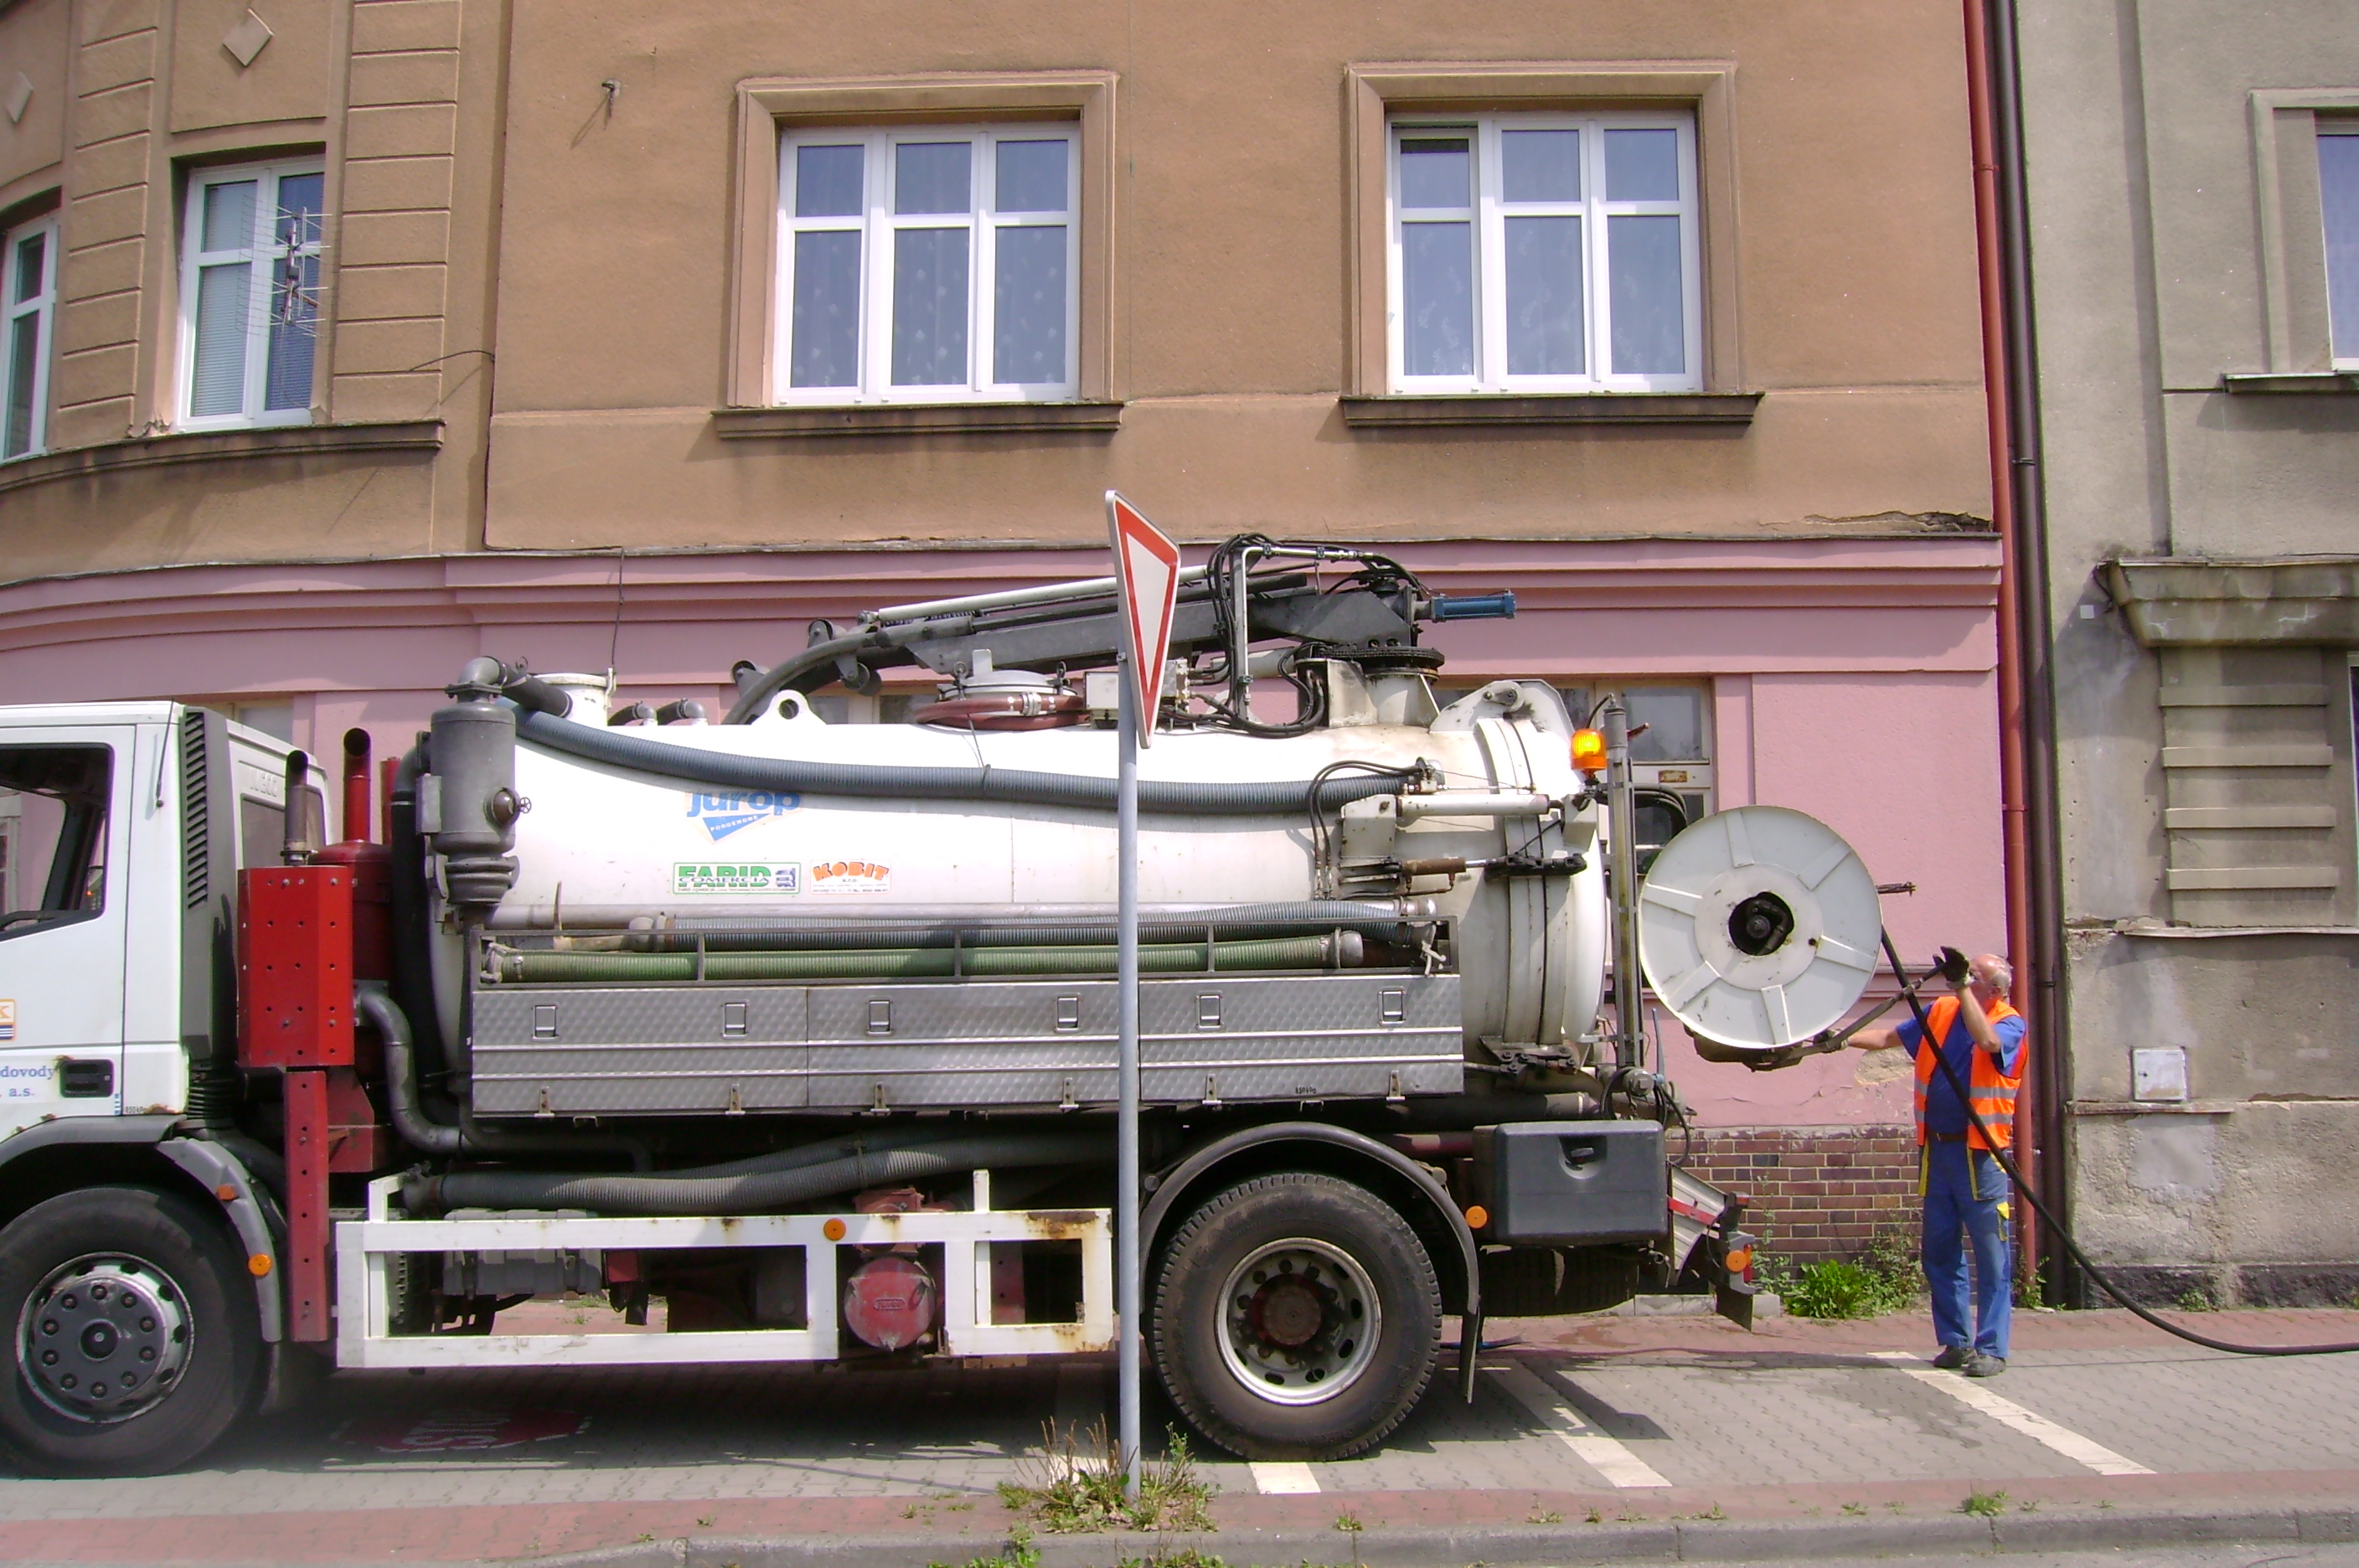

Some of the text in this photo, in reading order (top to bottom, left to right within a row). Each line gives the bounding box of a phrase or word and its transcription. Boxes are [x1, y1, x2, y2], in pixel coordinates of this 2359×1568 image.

[687, 791, 801, 818] jurop
[710, 815, 759, 832] PORDENONE
[678, 865, 772, 888] FARID
[813, 861, 890, 881] KOBIT
[0, 1065, 54, 1080] dovody
[9, 1087, 35, 1097] a.s.
